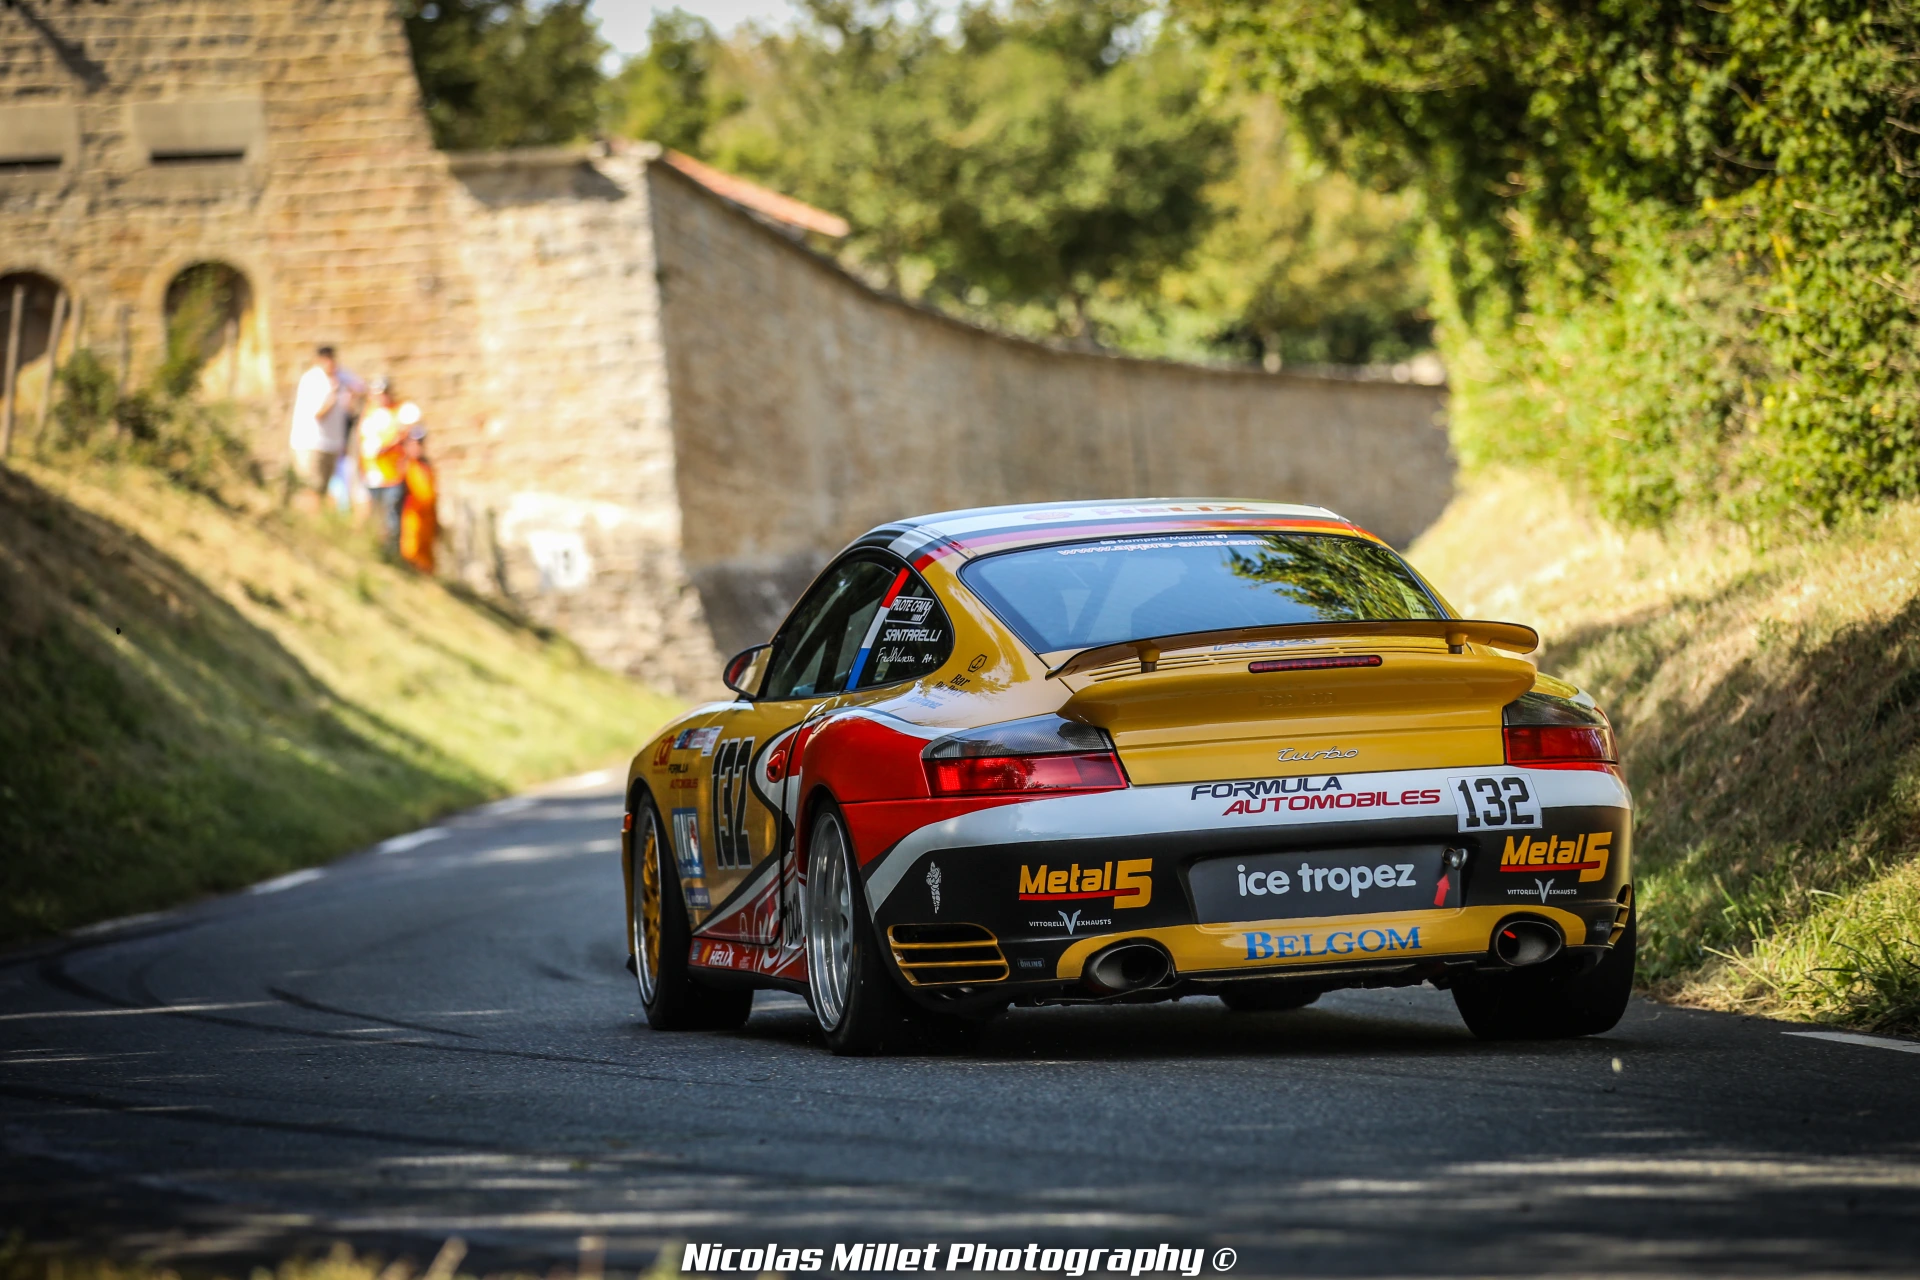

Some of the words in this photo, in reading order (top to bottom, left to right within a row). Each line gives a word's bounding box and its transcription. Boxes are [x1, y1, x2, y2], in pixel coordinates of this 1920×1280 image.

[1117, 536, 1166, 544] Rampon
[890, 599, 912, 611] PILOTE
[883, 629, 942, 642] SANTARELLI
[950, 674, 970, 687] Bar
[1277, 747, 1358, 762] turbo
[1191, 776, 1342, 800] FORMULA
[712, 736, 755, 870] 132
[1222, 789, 1441, 816] AUTOMOBILES
[1457, 777, 1535, 828] 132
[1237, 863, 1291, 897] ice
[1300, 862, 1417, 899] tropez
[1507, 888, 1539, 896] VITTORELLI
[1549, 888, 1577, 896] EXHAUSTS
[1029, 920, 1065, 928] VITTORELLI
[1076, 918, 1112, 927] EXHAUSTS
[1243, 926, 1423, 961] BELGOM
[708, 947, 735, 967] HELIX
